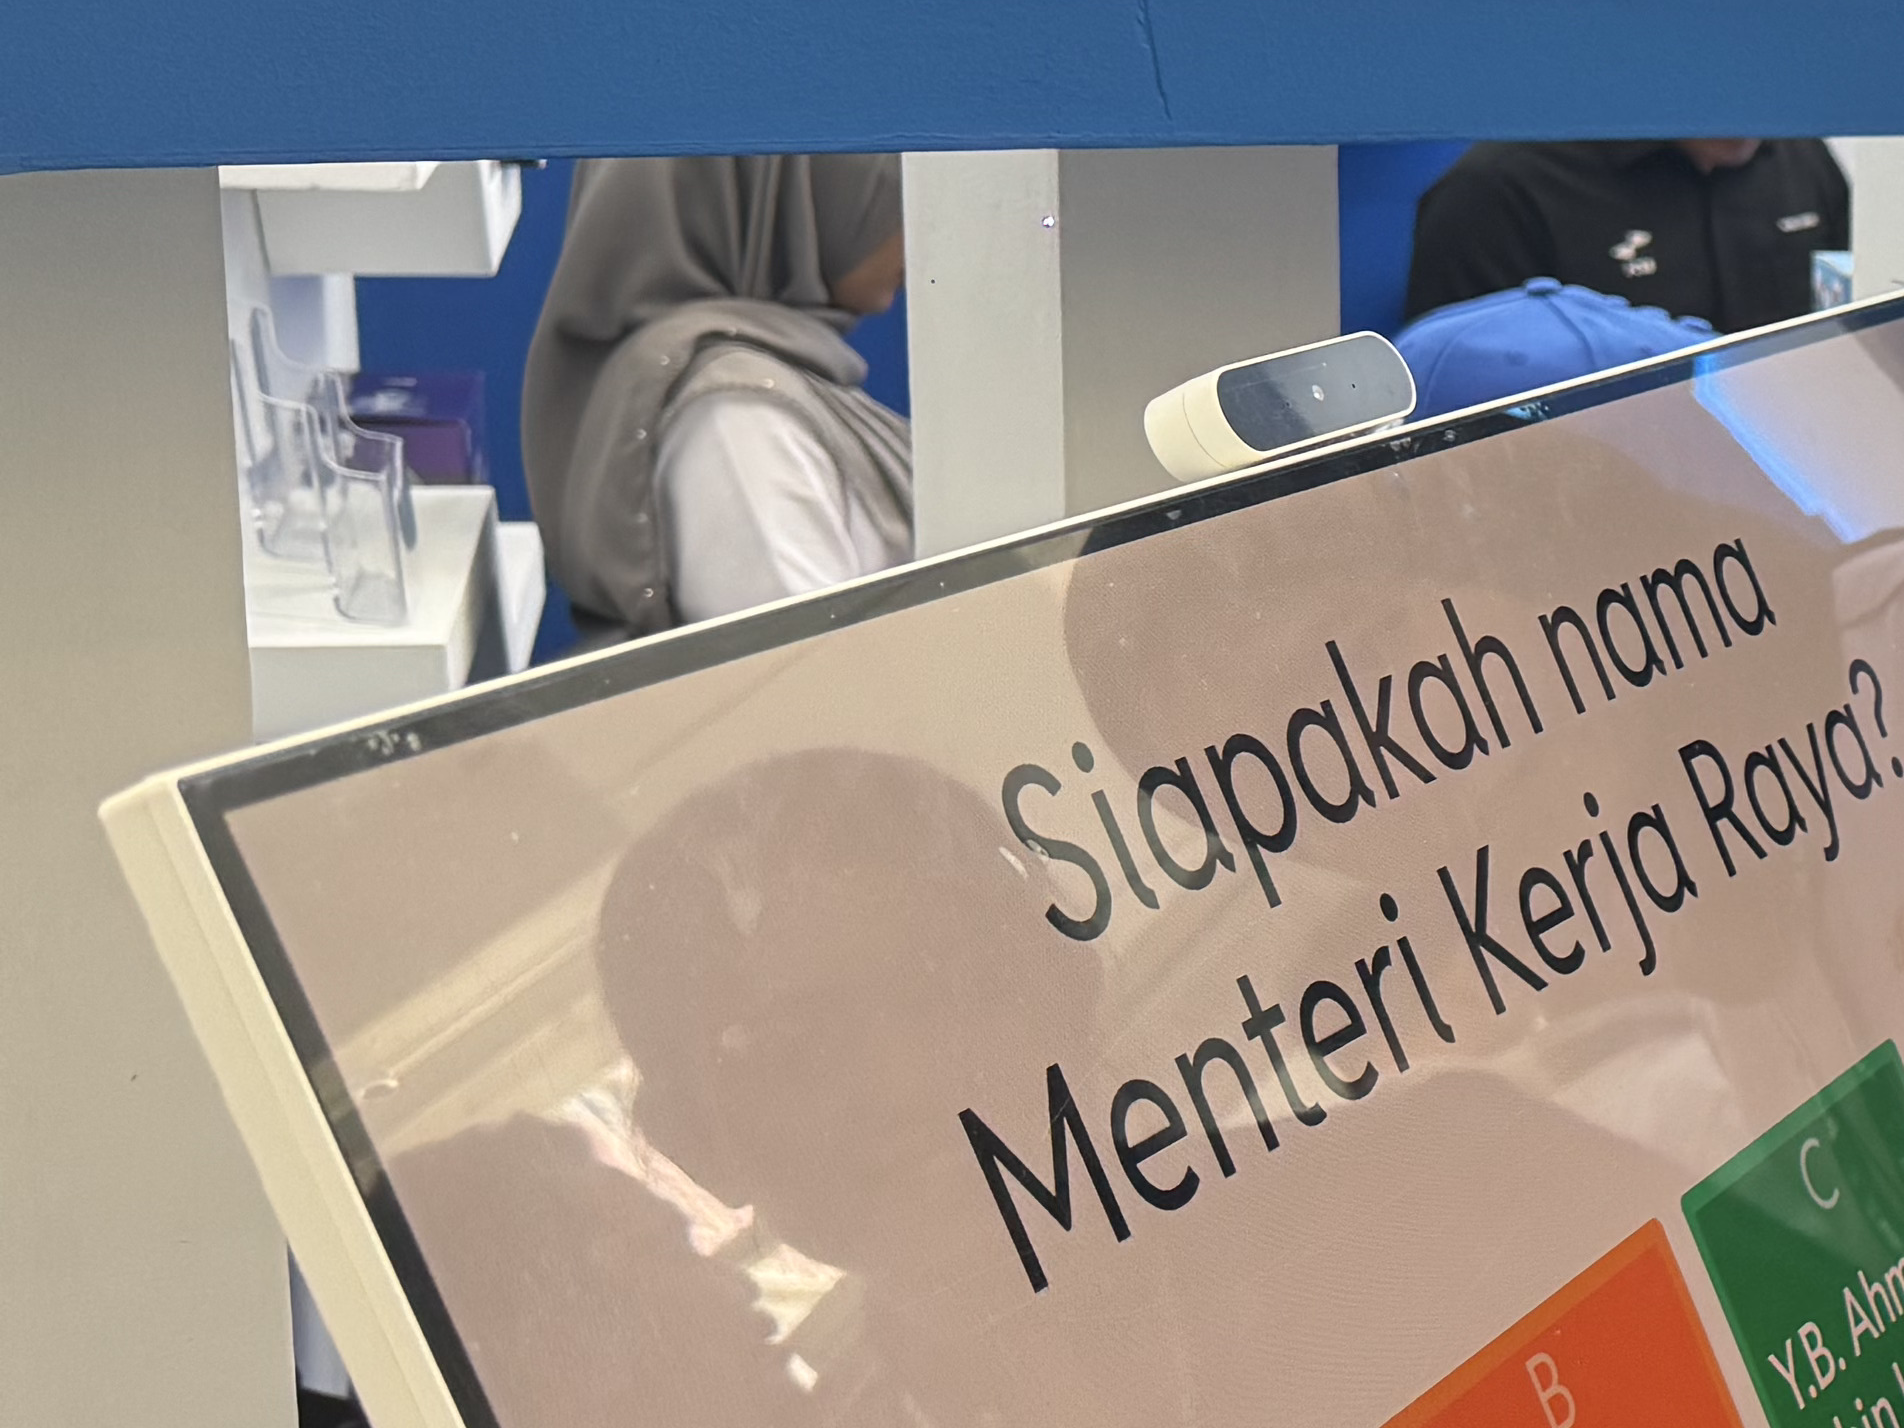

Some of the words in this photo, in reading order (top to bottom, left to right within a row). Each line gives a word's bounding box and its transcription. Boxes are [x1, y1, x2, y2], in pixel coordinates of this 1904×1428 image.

[1000, 598, 1543, 943] Siapakah
[1537, 537, 1776, 715] nama
[957, 893, 1455, 1294] Menteri
[1437, 792, 1698, 1015] Kerja
[1677, 658, 1904, 879] Raya?
[1798, 1136, 1841, 1211] C
[1768, 1320, 1847, 1413] Y.B.
